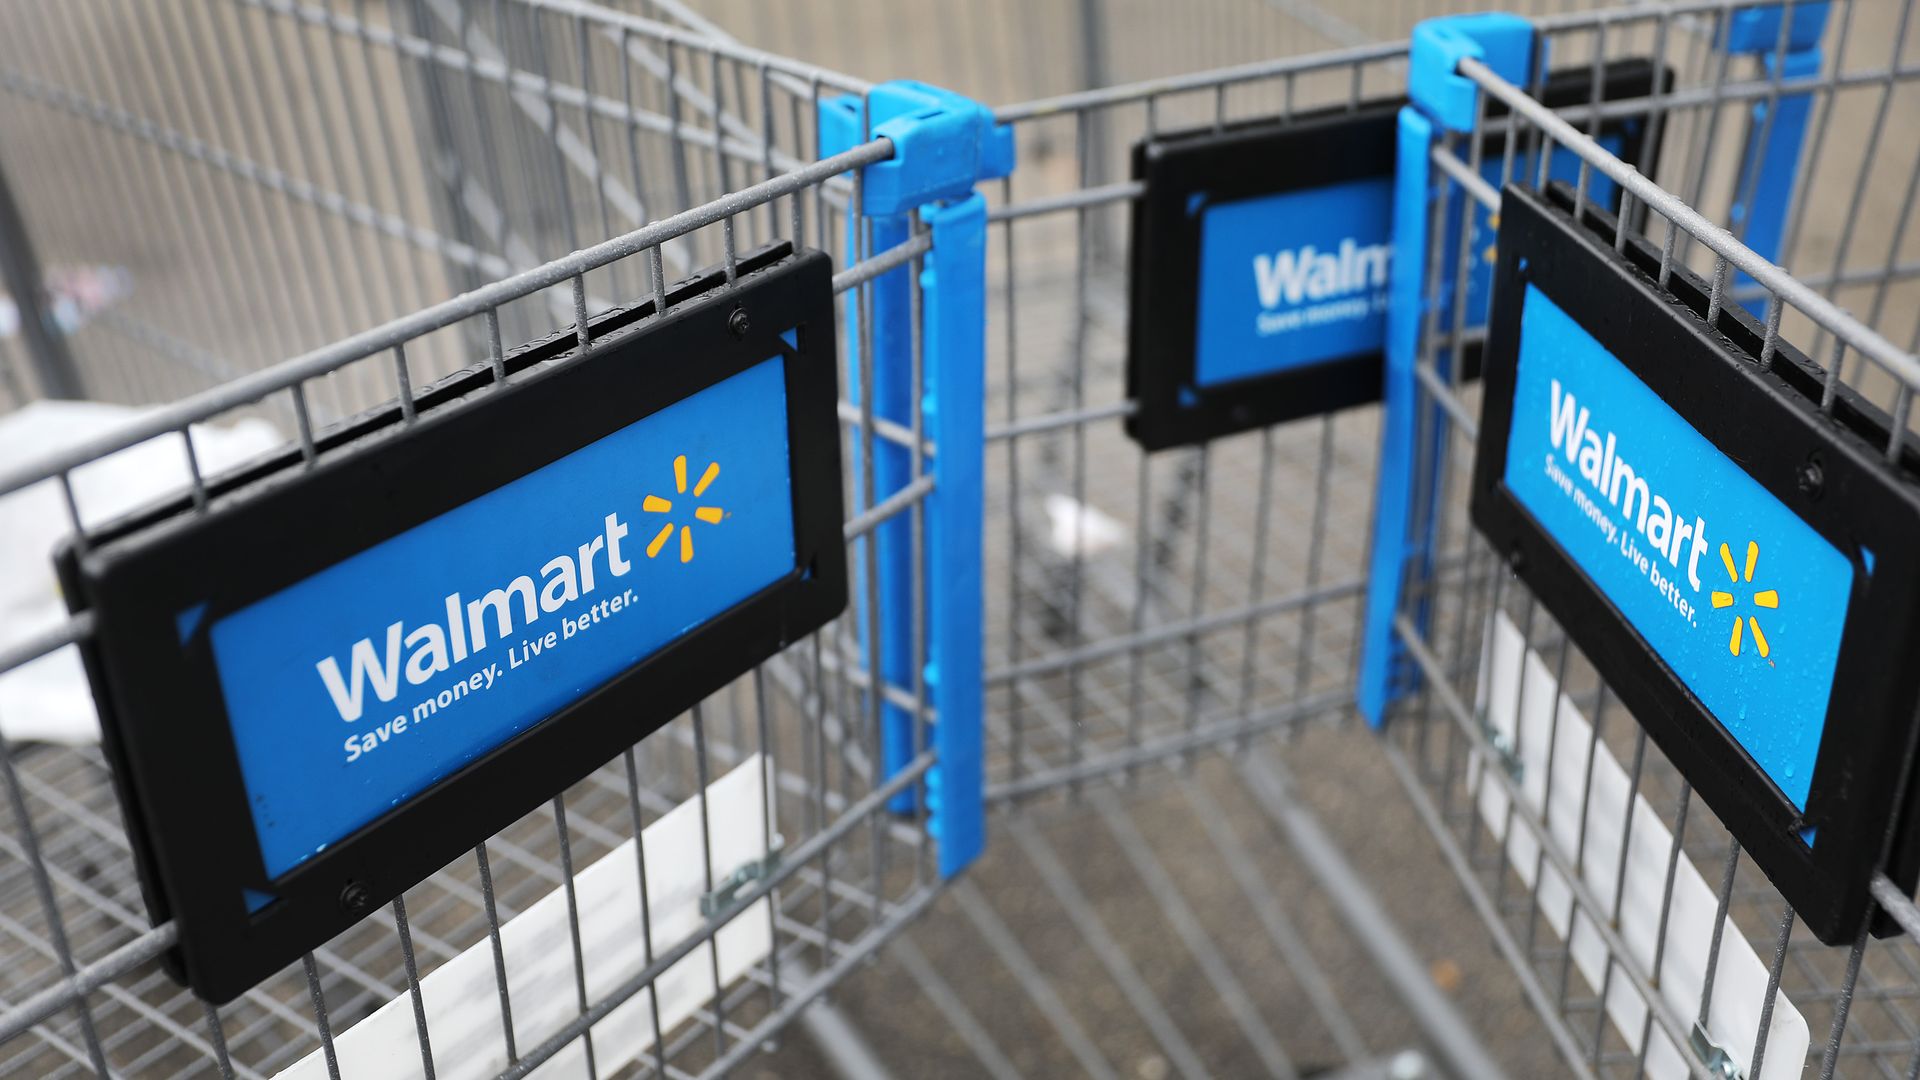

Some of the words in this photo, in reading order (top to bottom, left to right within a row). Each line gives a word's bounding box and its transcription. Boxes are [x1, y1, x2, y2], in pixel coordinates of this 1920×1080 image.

[1254, 238, 1393, 309] Walm
[1544, 453, 1574, 493] Save
[1572, 486, 1619, 545] money.
[1620, 531, 1649, 574] Live
[1650, 561, 1697, 628] better.
[1550, 378, 1709, 593] Walmart
[316, 512, 631, 723] Walmart
[343, 715, 408, 763] Save
[413, 664, 503, 724] money.
[508, 632, 557, 670] Live
[562, 586, 639, 640] better.
